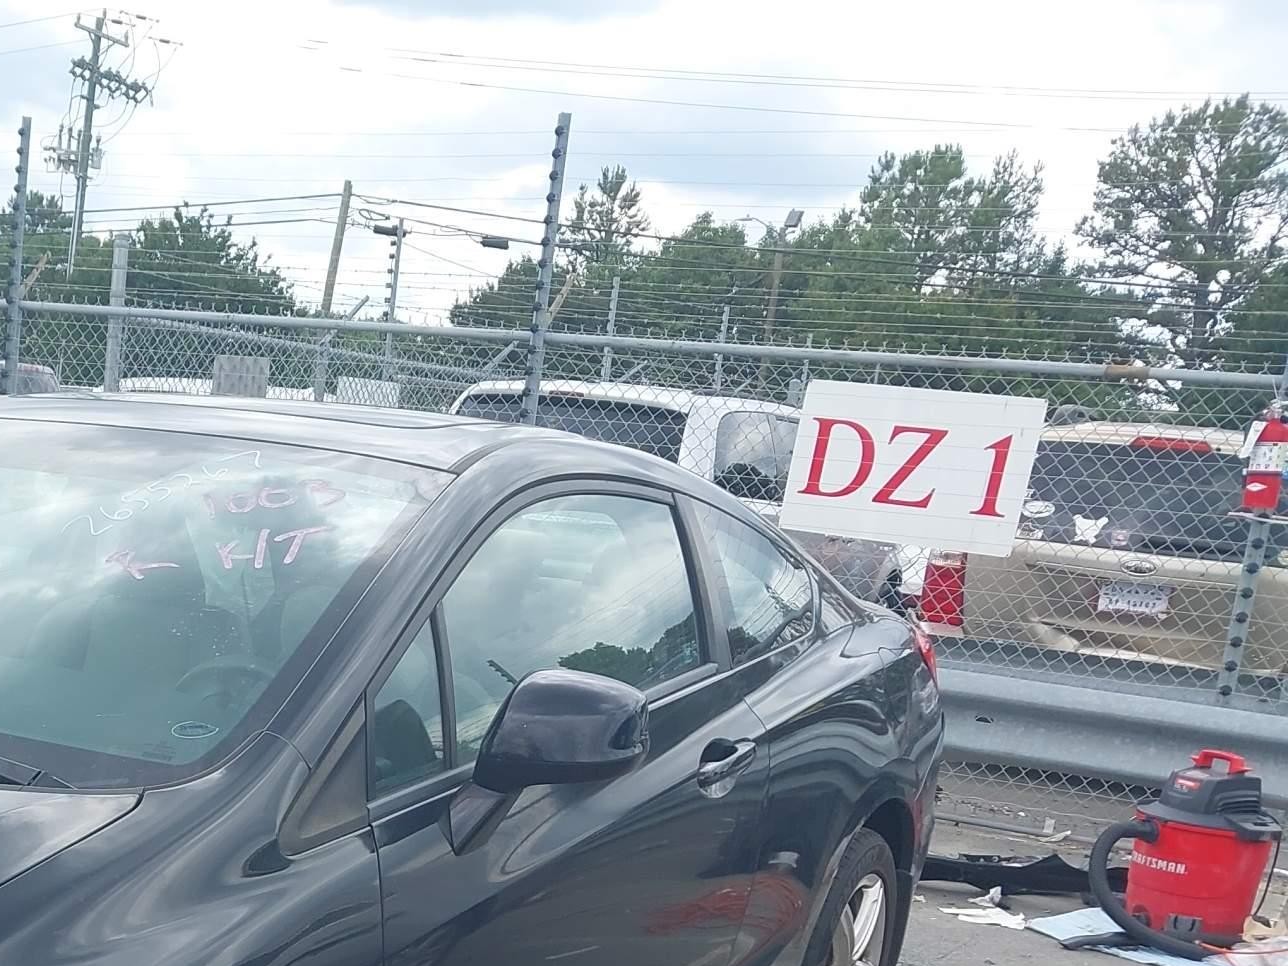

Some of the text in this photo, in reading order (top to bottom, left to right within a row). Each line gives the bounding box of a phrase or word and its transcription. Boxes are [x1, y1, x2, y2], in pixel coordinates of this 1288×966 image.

[797, 416, 1014, 518] DZ 1
[1132, 850, 1186, 875] RAFTSMAN
